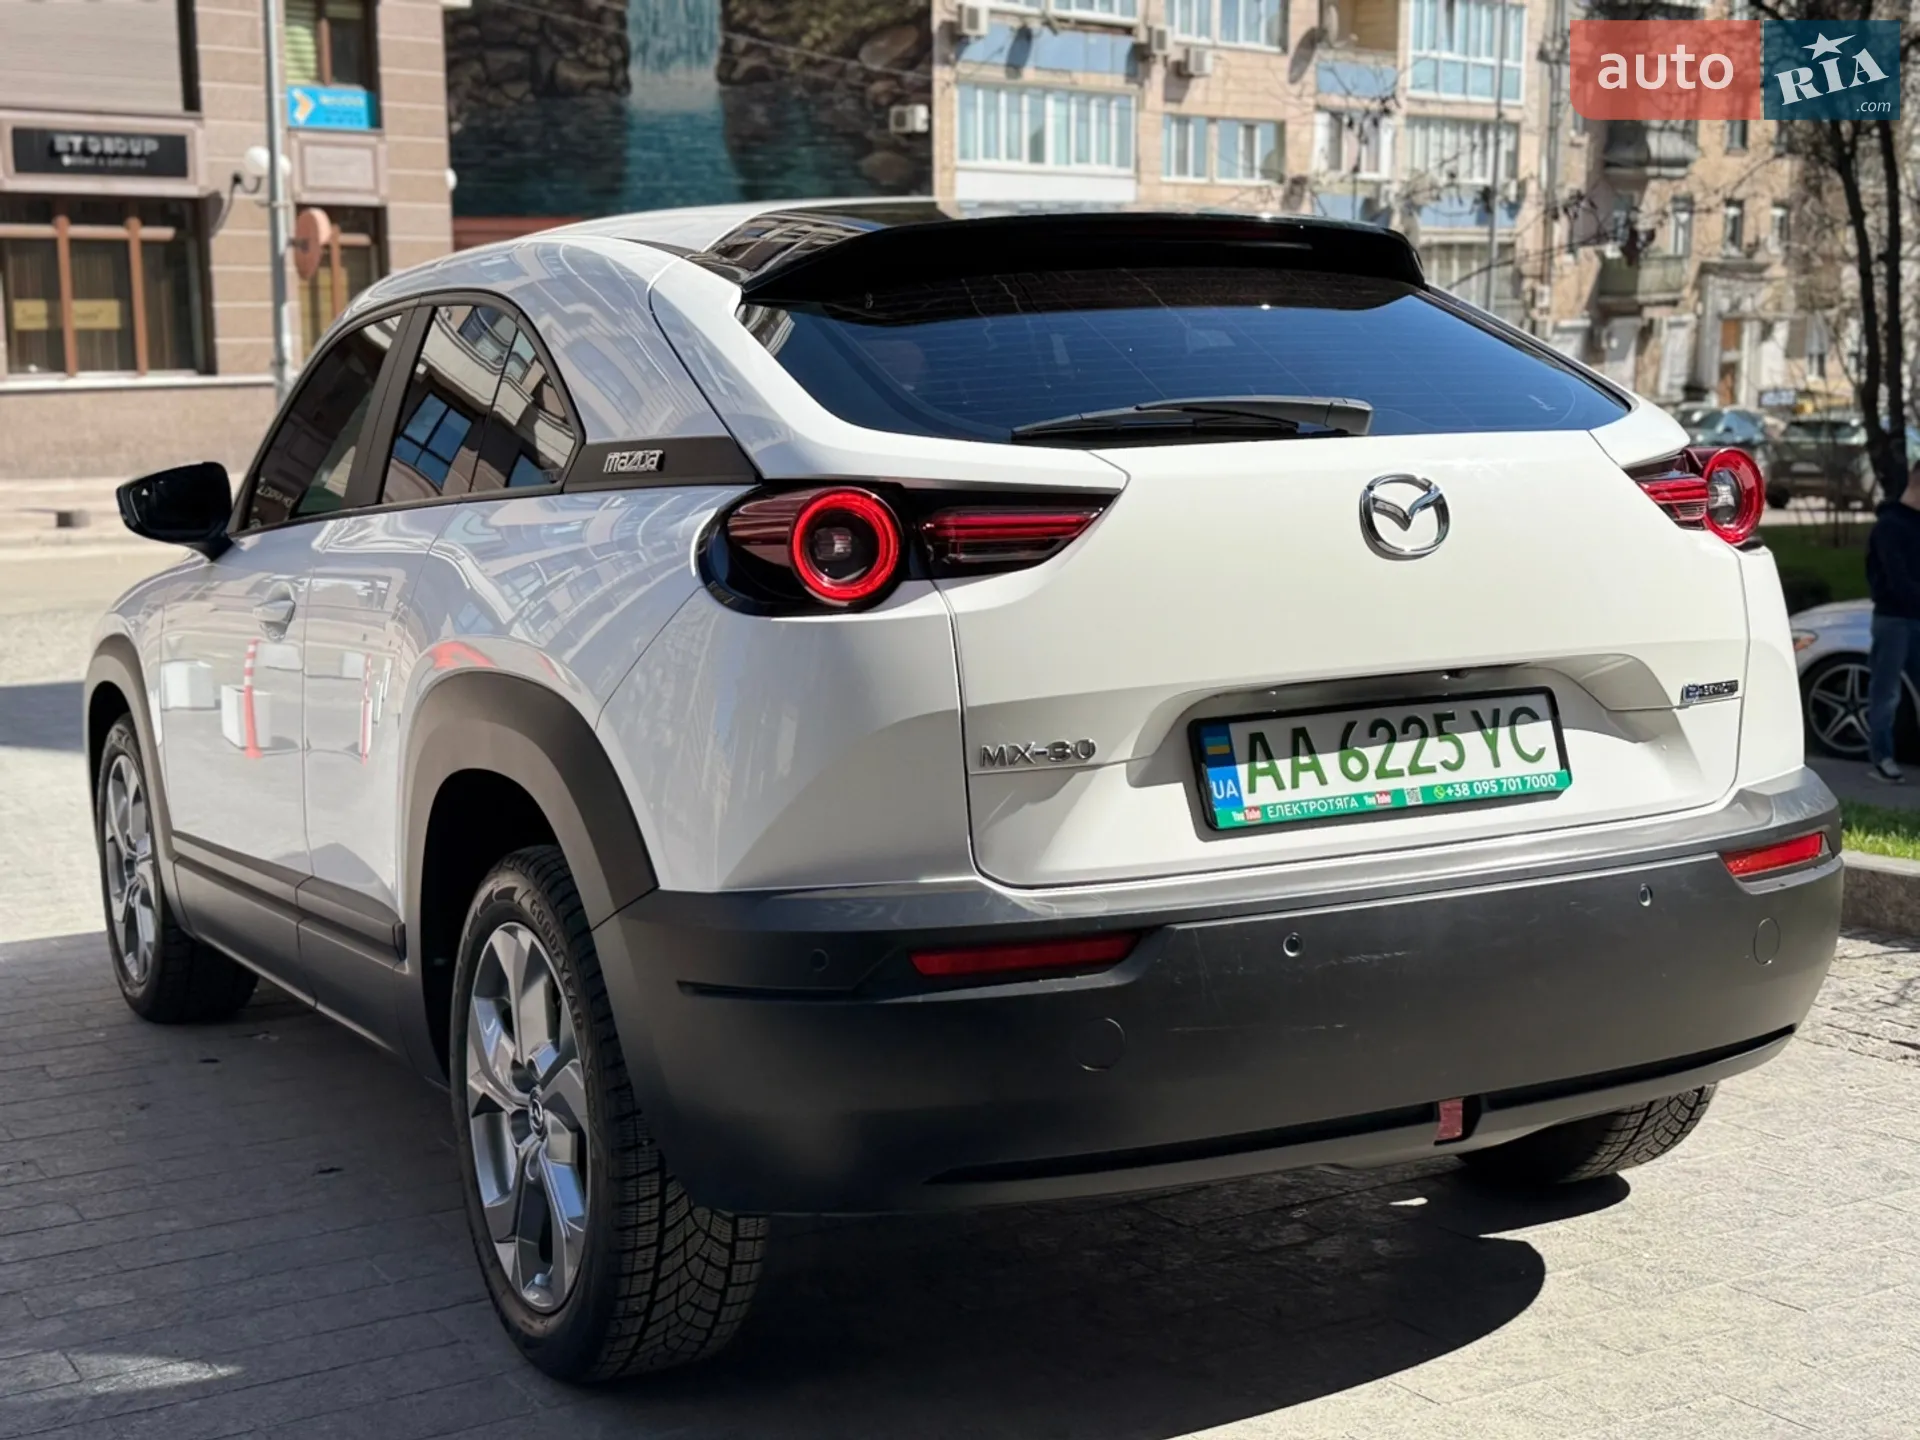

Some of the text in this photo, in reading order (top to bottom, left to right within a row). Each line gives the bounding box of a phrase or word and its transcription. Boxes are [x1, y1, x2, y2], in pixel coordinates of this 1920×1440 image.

[979, 738, 1098, 767] MX-30
[1248, 706, 1546, 794] AA 6225 YC
[1212, 778, 1240, 800] UA
[1445, 773, 1557, 798] +38 095 701 7000
[1267, 796, 1359, 819] ЕЛЕКТРОТЯГА
